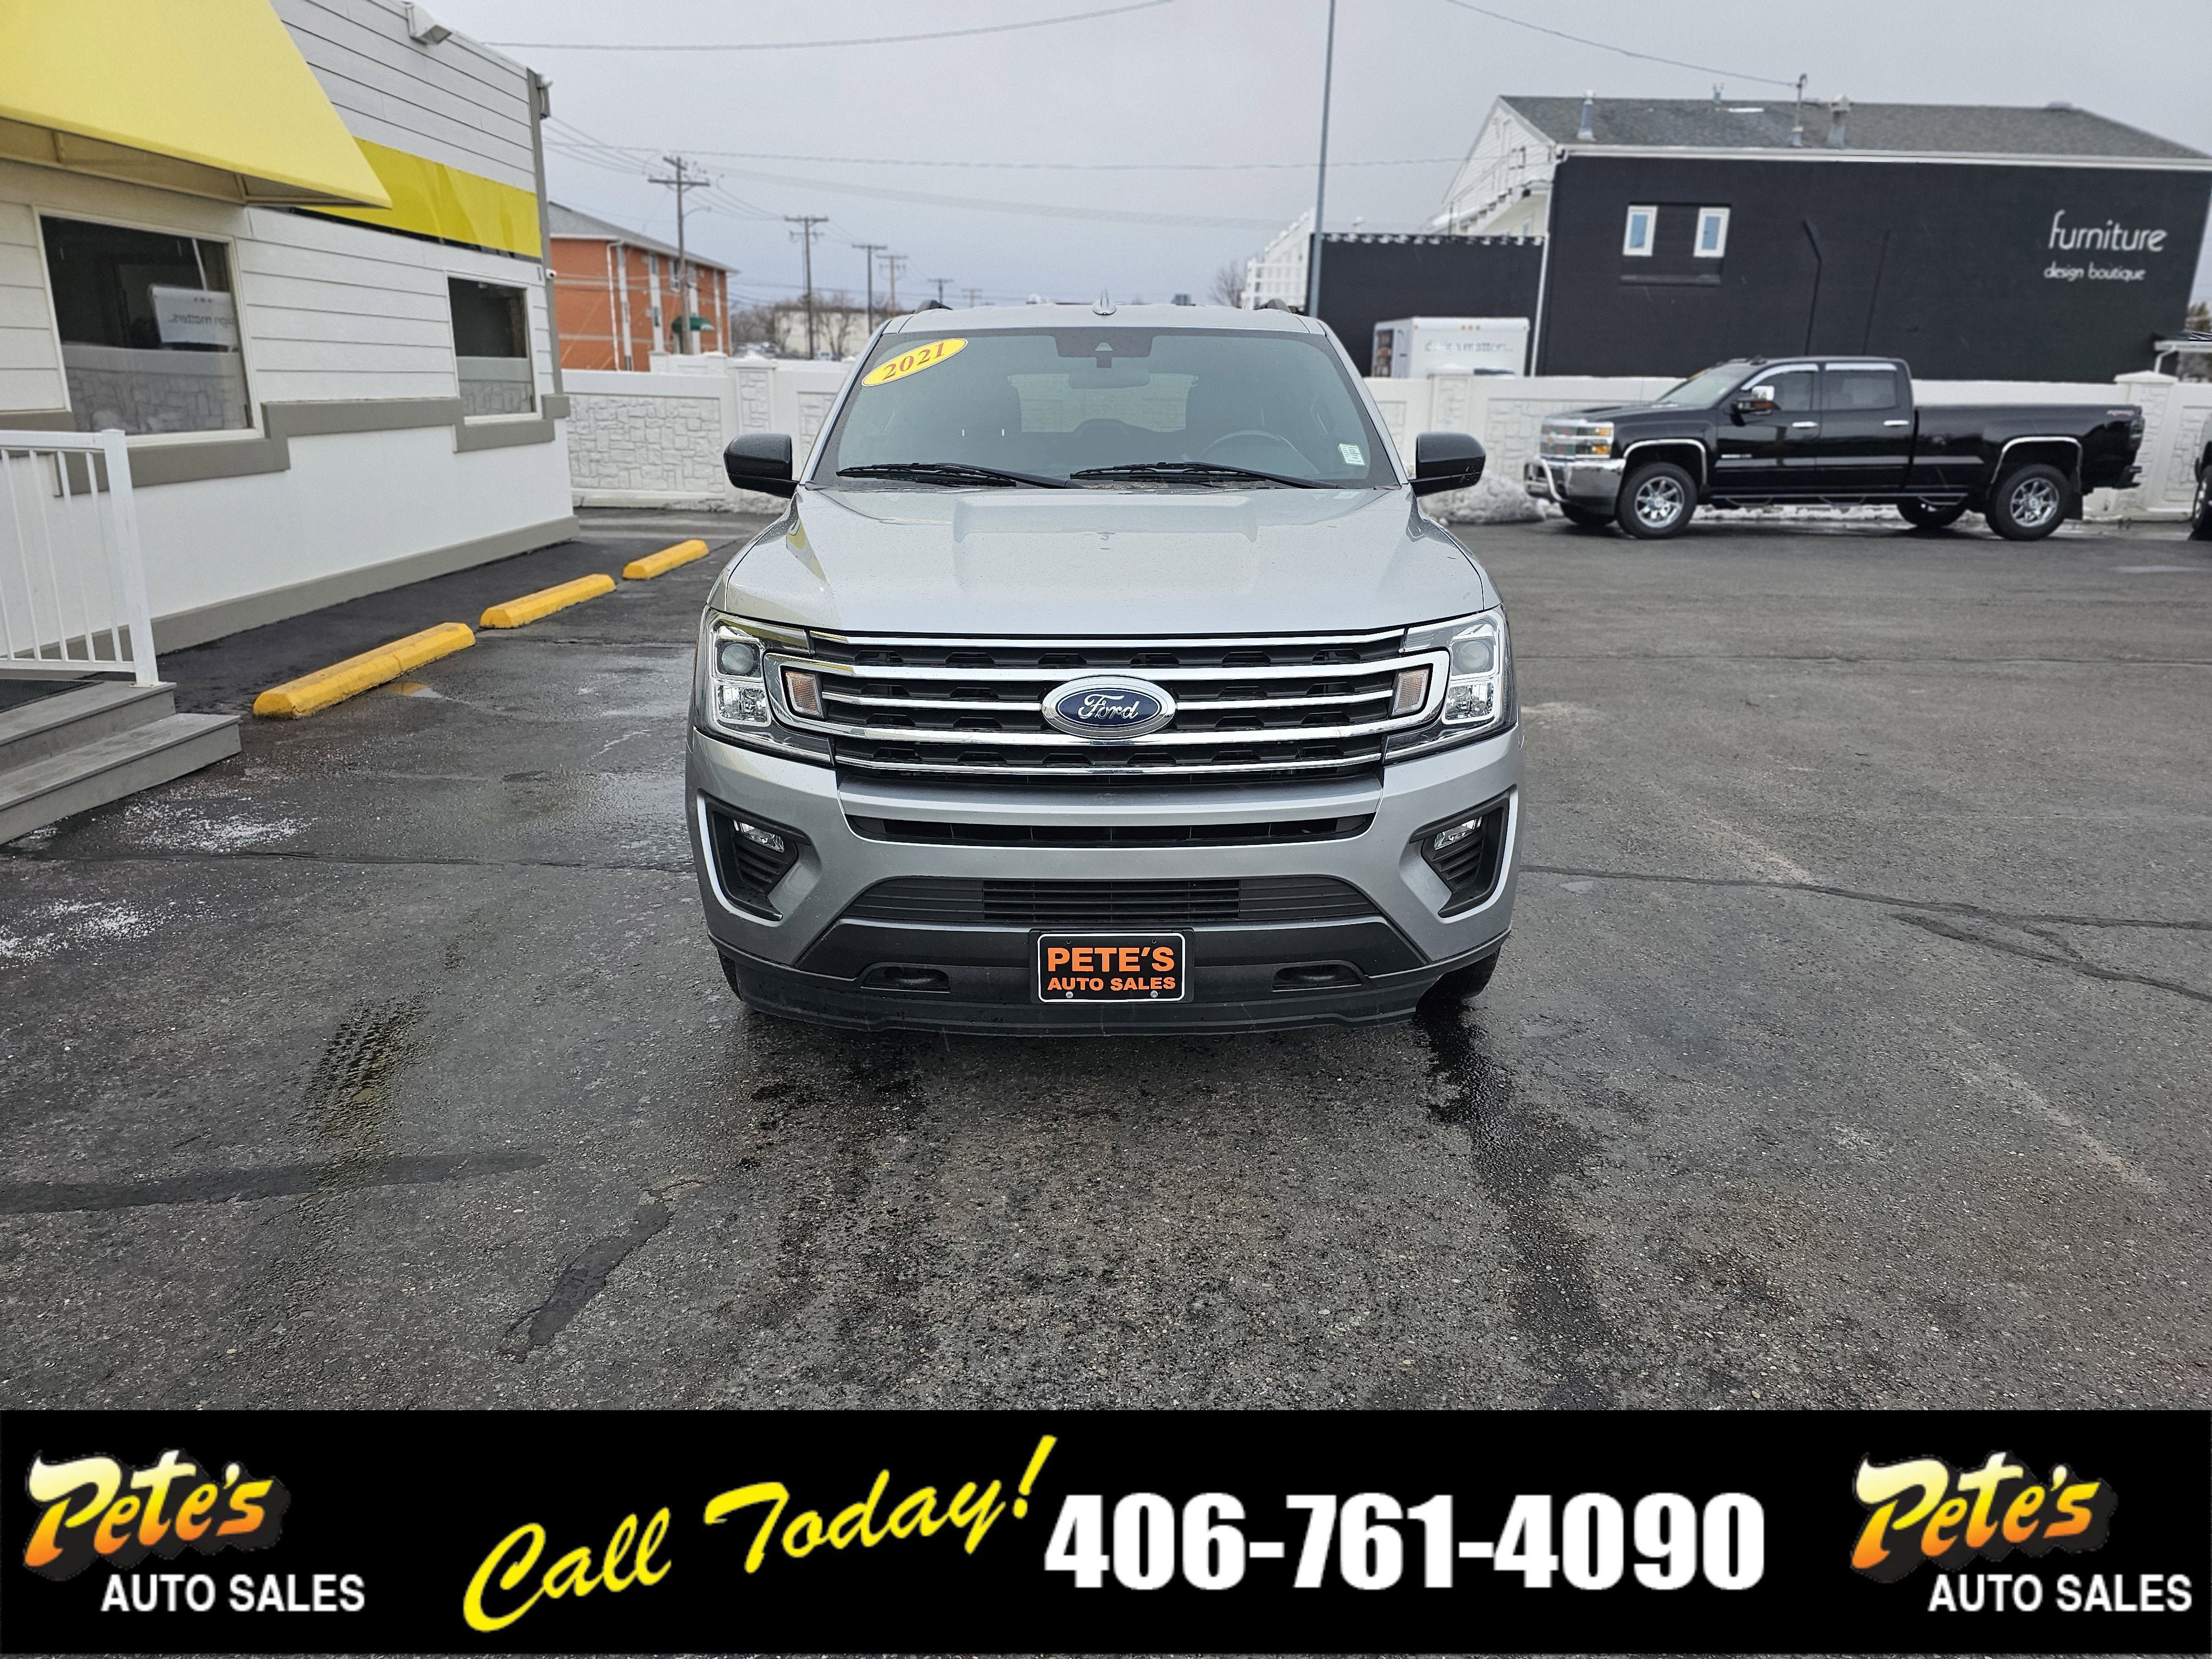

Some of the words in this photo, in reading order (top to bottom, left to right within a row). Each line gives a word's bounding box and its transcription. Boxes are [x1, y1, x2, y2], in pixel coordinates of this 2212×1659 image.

[2048, 210, 2168, 252] furniture
[2044, 261, 2084, 281] design
[2088, 262, 2146, 283] boutique
[882, 342, 945, 380] 2021
[1077, 694, 1139, 719] Ford
[1048, 947, 1175, 972] PETE'S
[1048, 978, 1104, 990] AUTO
[1110, 977, 1176, 990] SALES
